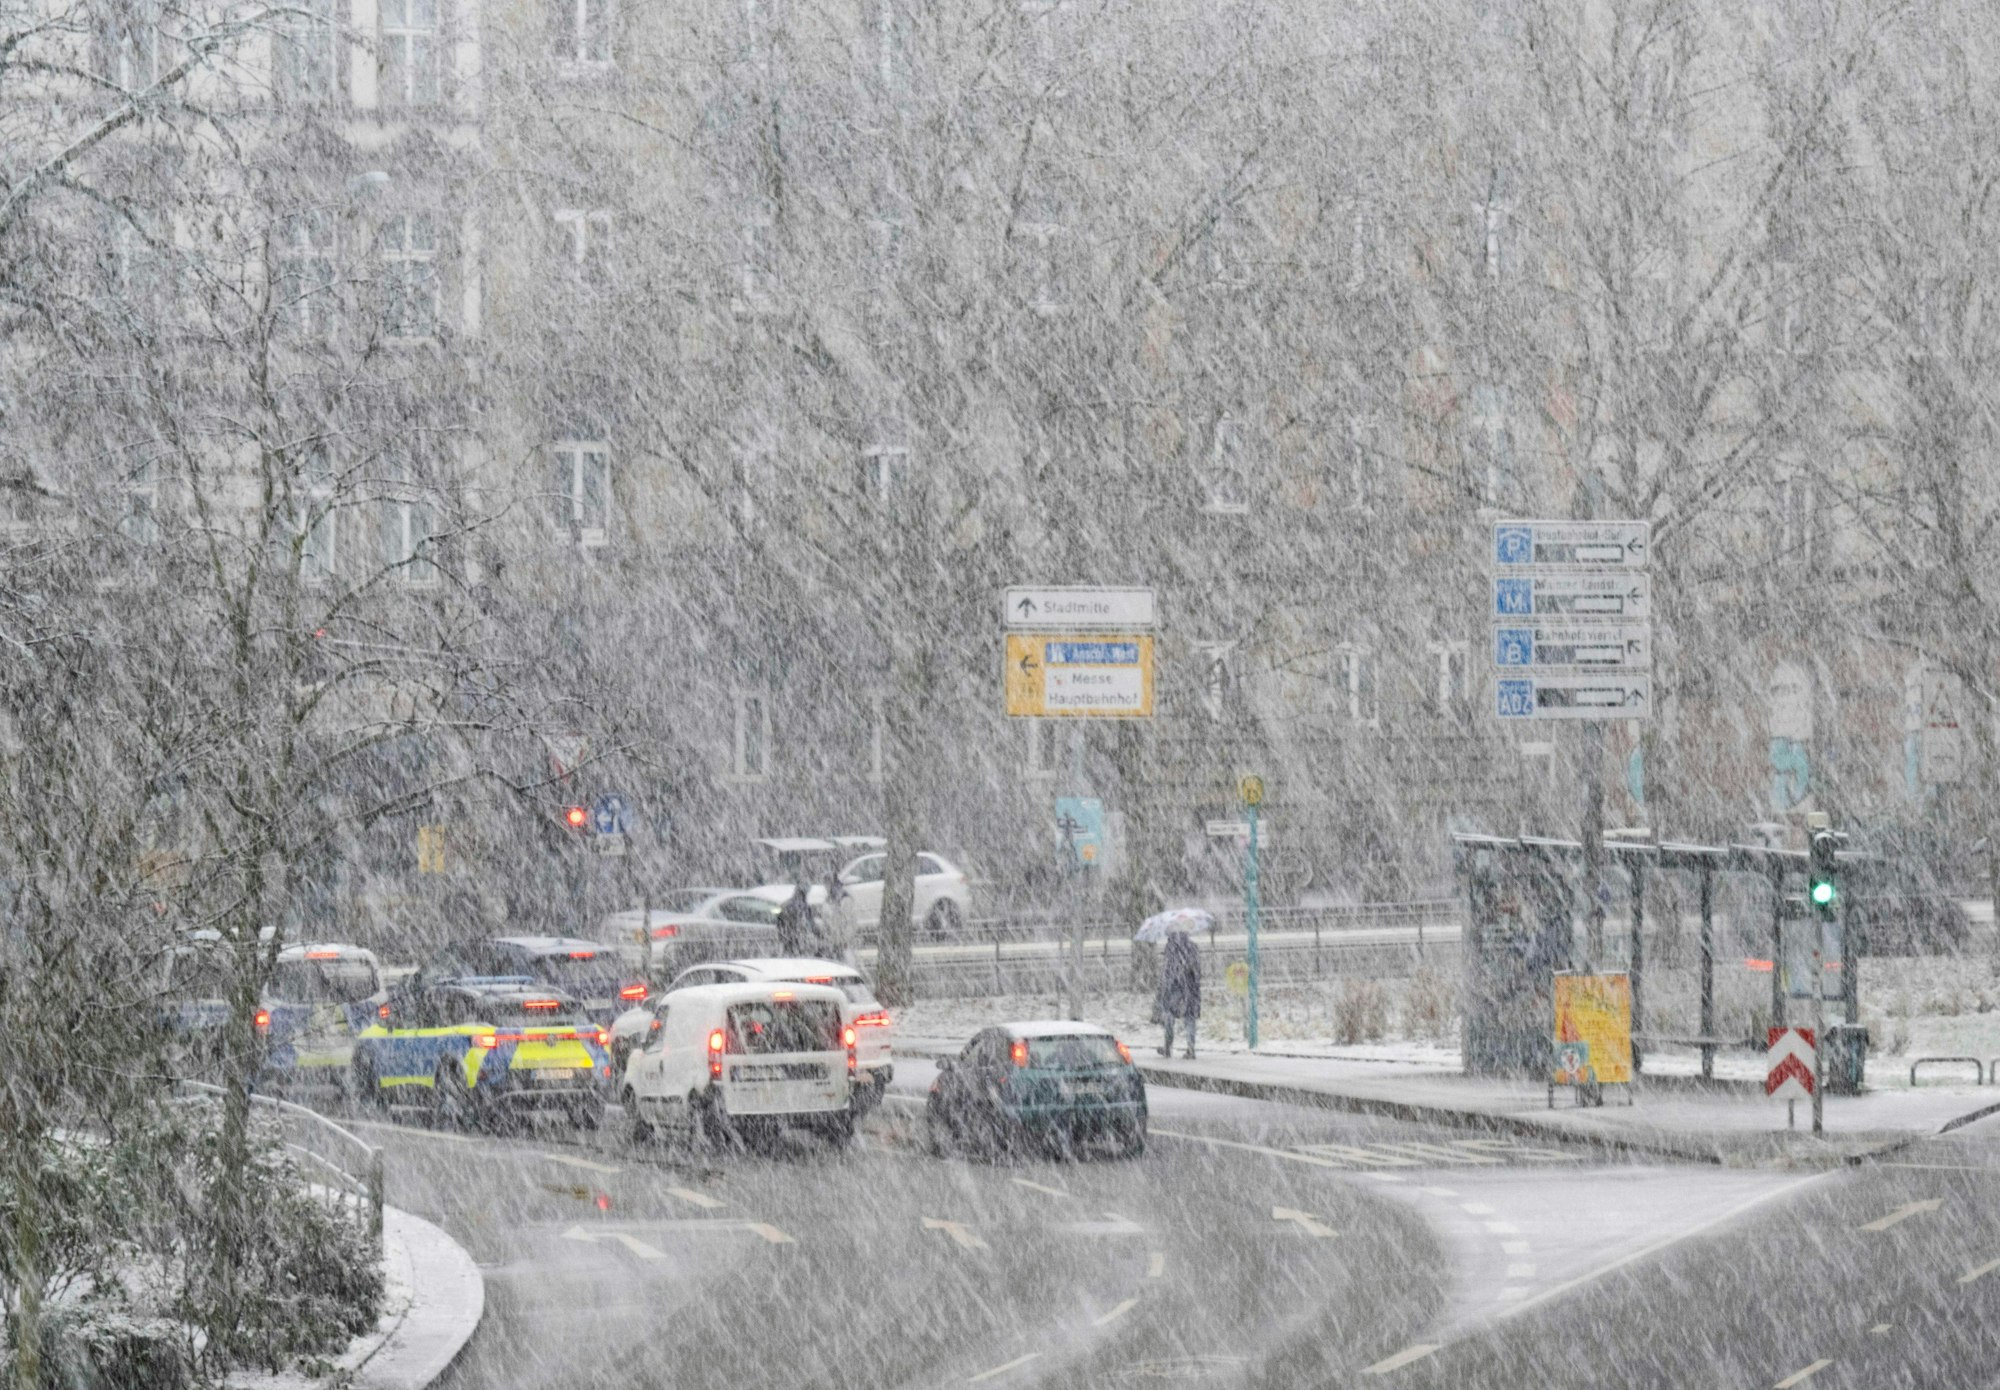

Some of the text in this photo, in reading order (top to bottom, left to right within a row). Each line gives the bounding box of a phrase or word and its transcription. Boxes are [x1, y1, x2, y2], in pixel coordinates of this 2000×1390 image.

[1044, 600, 1110, 614] Stadtmitte
[1072, 673, 1113, 685] Messe
[1048, 692, 1138, 706] Hauptbahnhof
